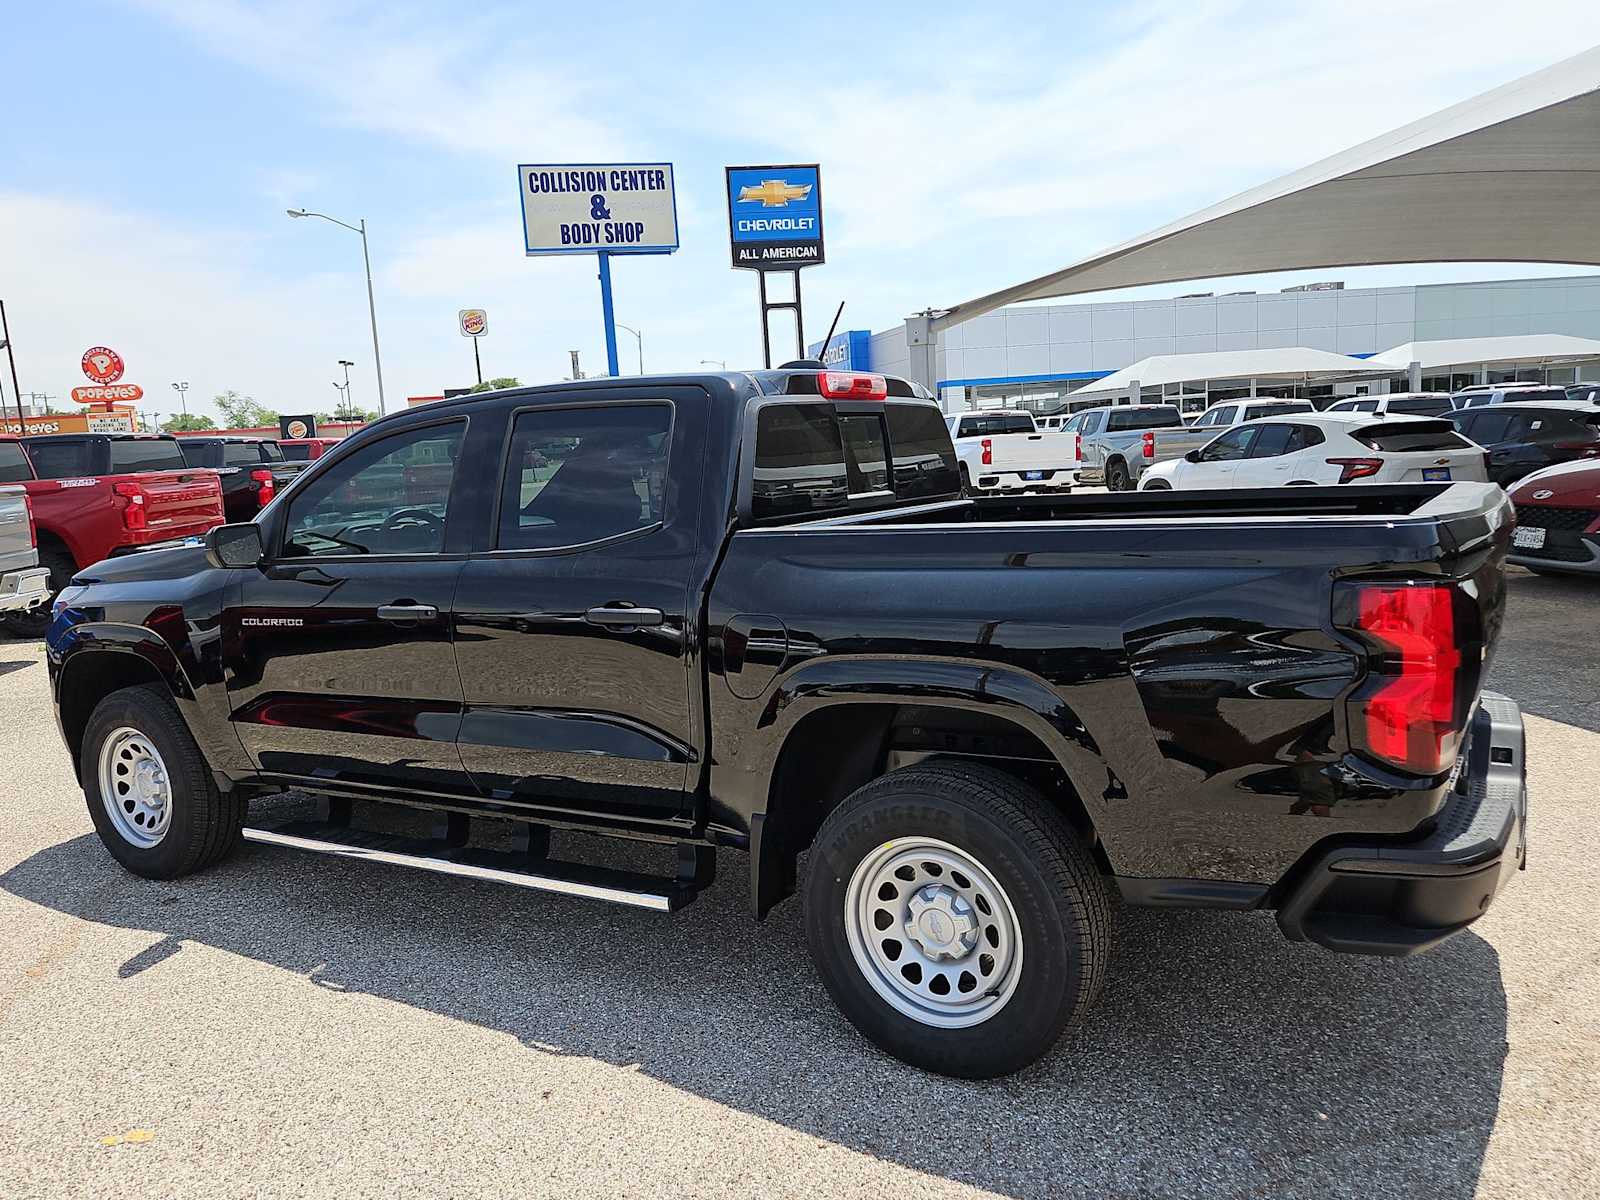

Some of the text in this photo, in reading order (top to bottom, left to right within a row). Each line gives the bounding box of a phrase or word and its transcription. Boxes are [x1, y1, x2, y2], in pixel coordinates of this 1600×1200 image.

[528, 169, 666, 194] COLLISION CENTER
[590, 193, 611, 221] &
[738, 217, 815, 233] CHEVROLET
[560, 222, 644, 245] BODY SHOP
[739, 246, 818, 260] ALL AMERICAN
[465, 319, 483, 331] KING
[241, 618, 304, 627] COLORADO
